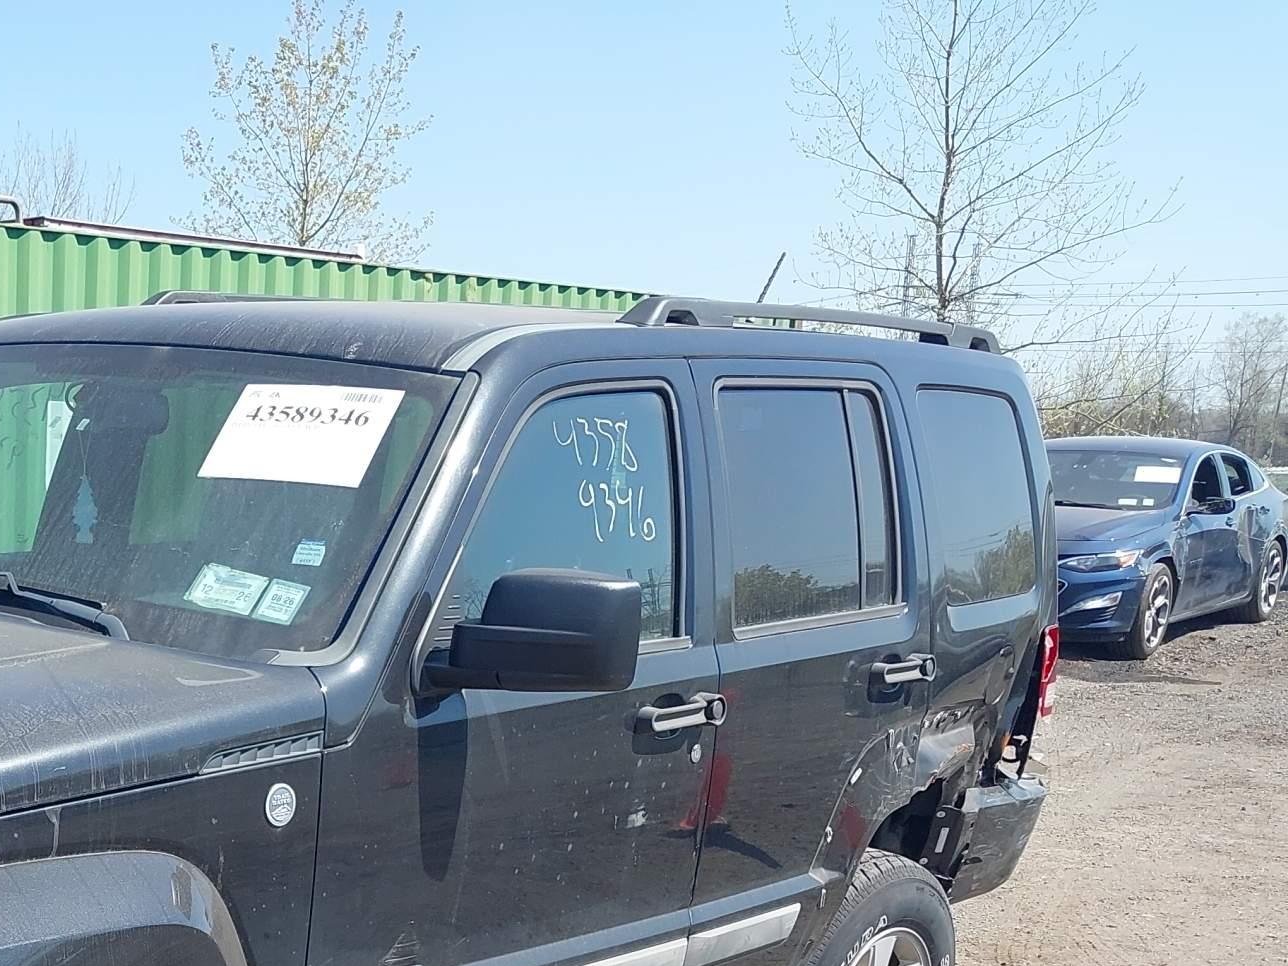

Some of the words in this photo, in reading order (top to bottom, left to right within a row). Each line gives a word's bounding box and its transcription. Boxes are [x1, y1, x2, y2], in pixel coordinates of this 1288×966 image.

[245, 404, 372, 428] 43589346
[552, 417, 638, 472] 4358
[578, 479, 656, 543] 9346
